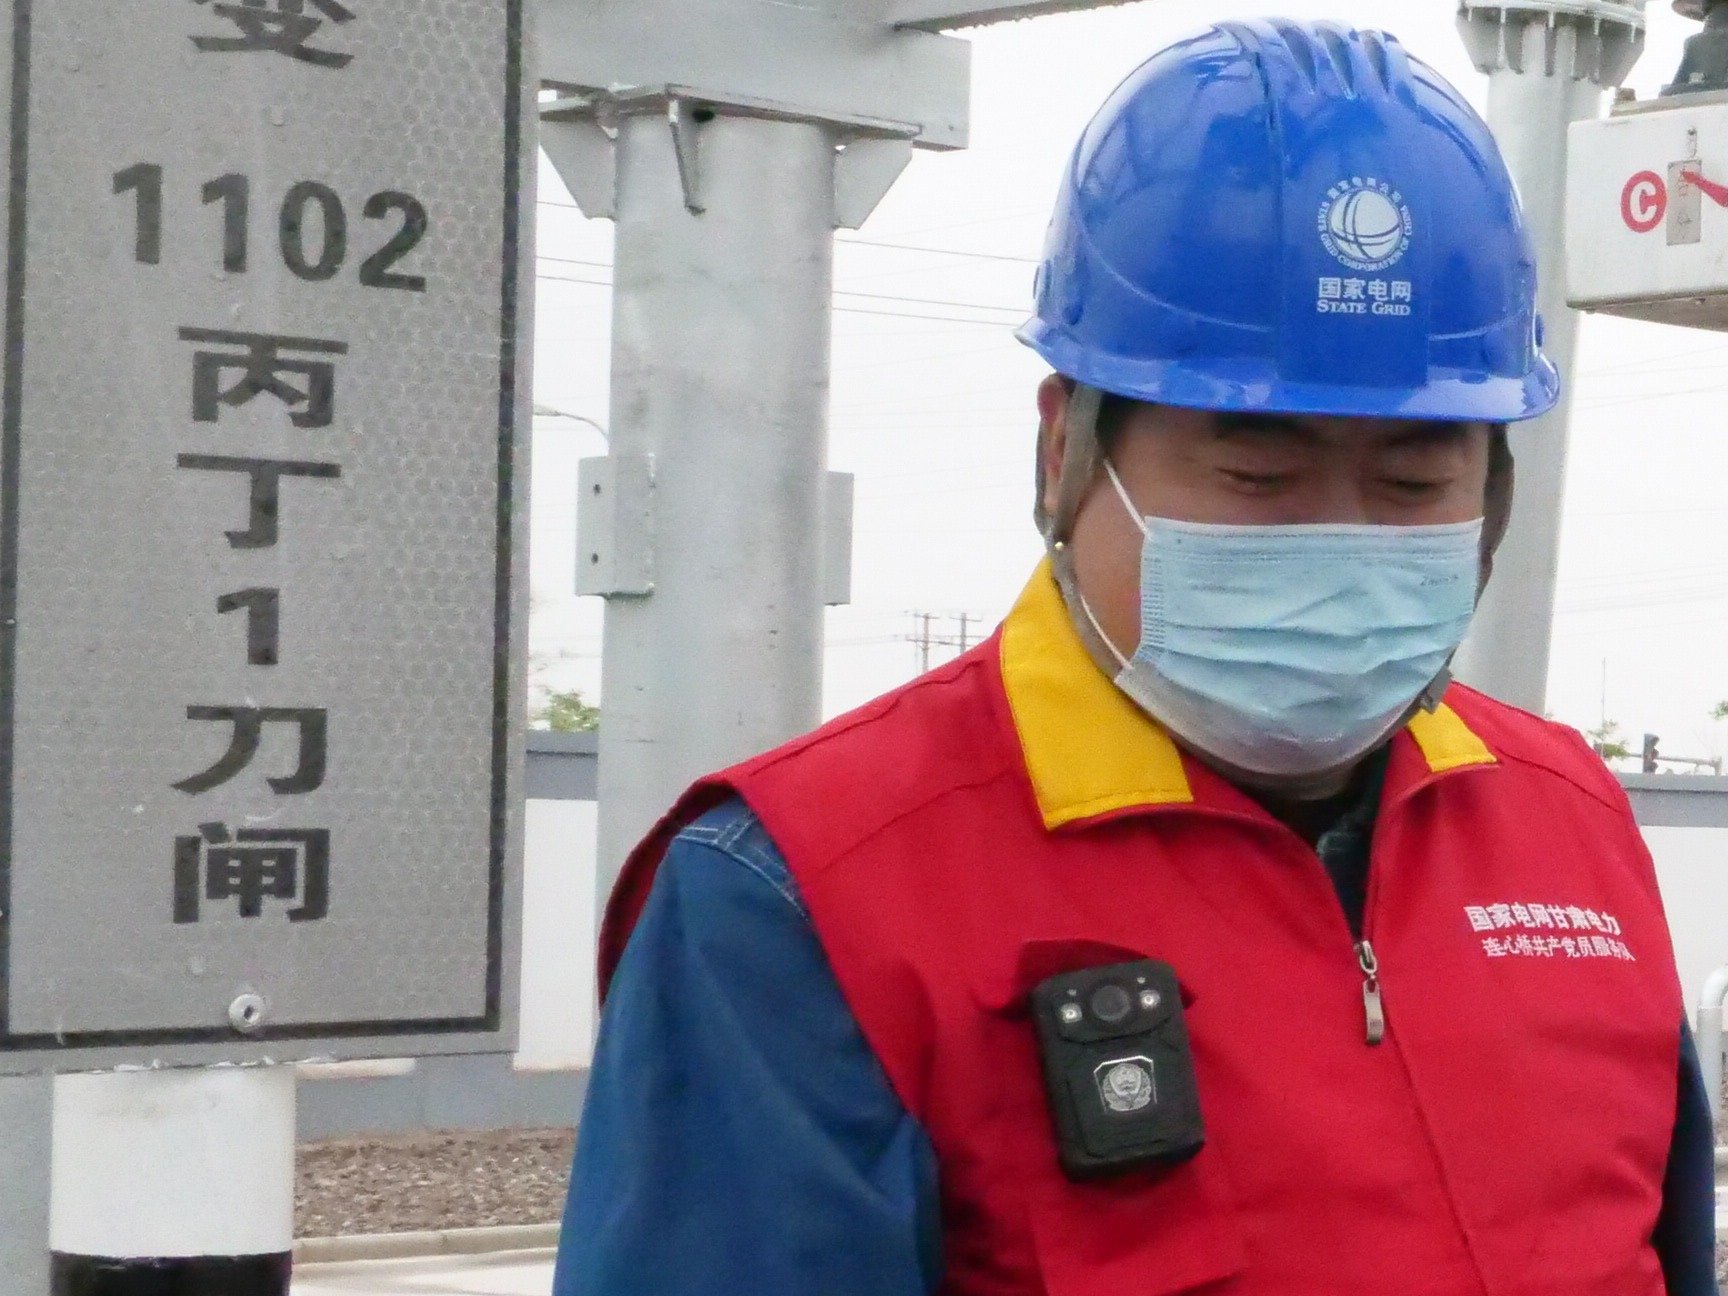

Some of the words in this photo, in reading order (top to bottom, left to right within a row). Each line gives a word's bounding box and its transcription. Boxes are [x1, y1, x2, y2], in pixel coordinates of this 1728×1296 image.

[1630, 181, 1657, 223] C
[111, 161, 428, 294] 1102
[1318, 277, 1411, 302] 国家电网
[1317, 300, 1368, 315] STATE
[1371, 301, 1411, 316] GRID
[1463, 901, 1622, 936] 国家电网甘肃电力
